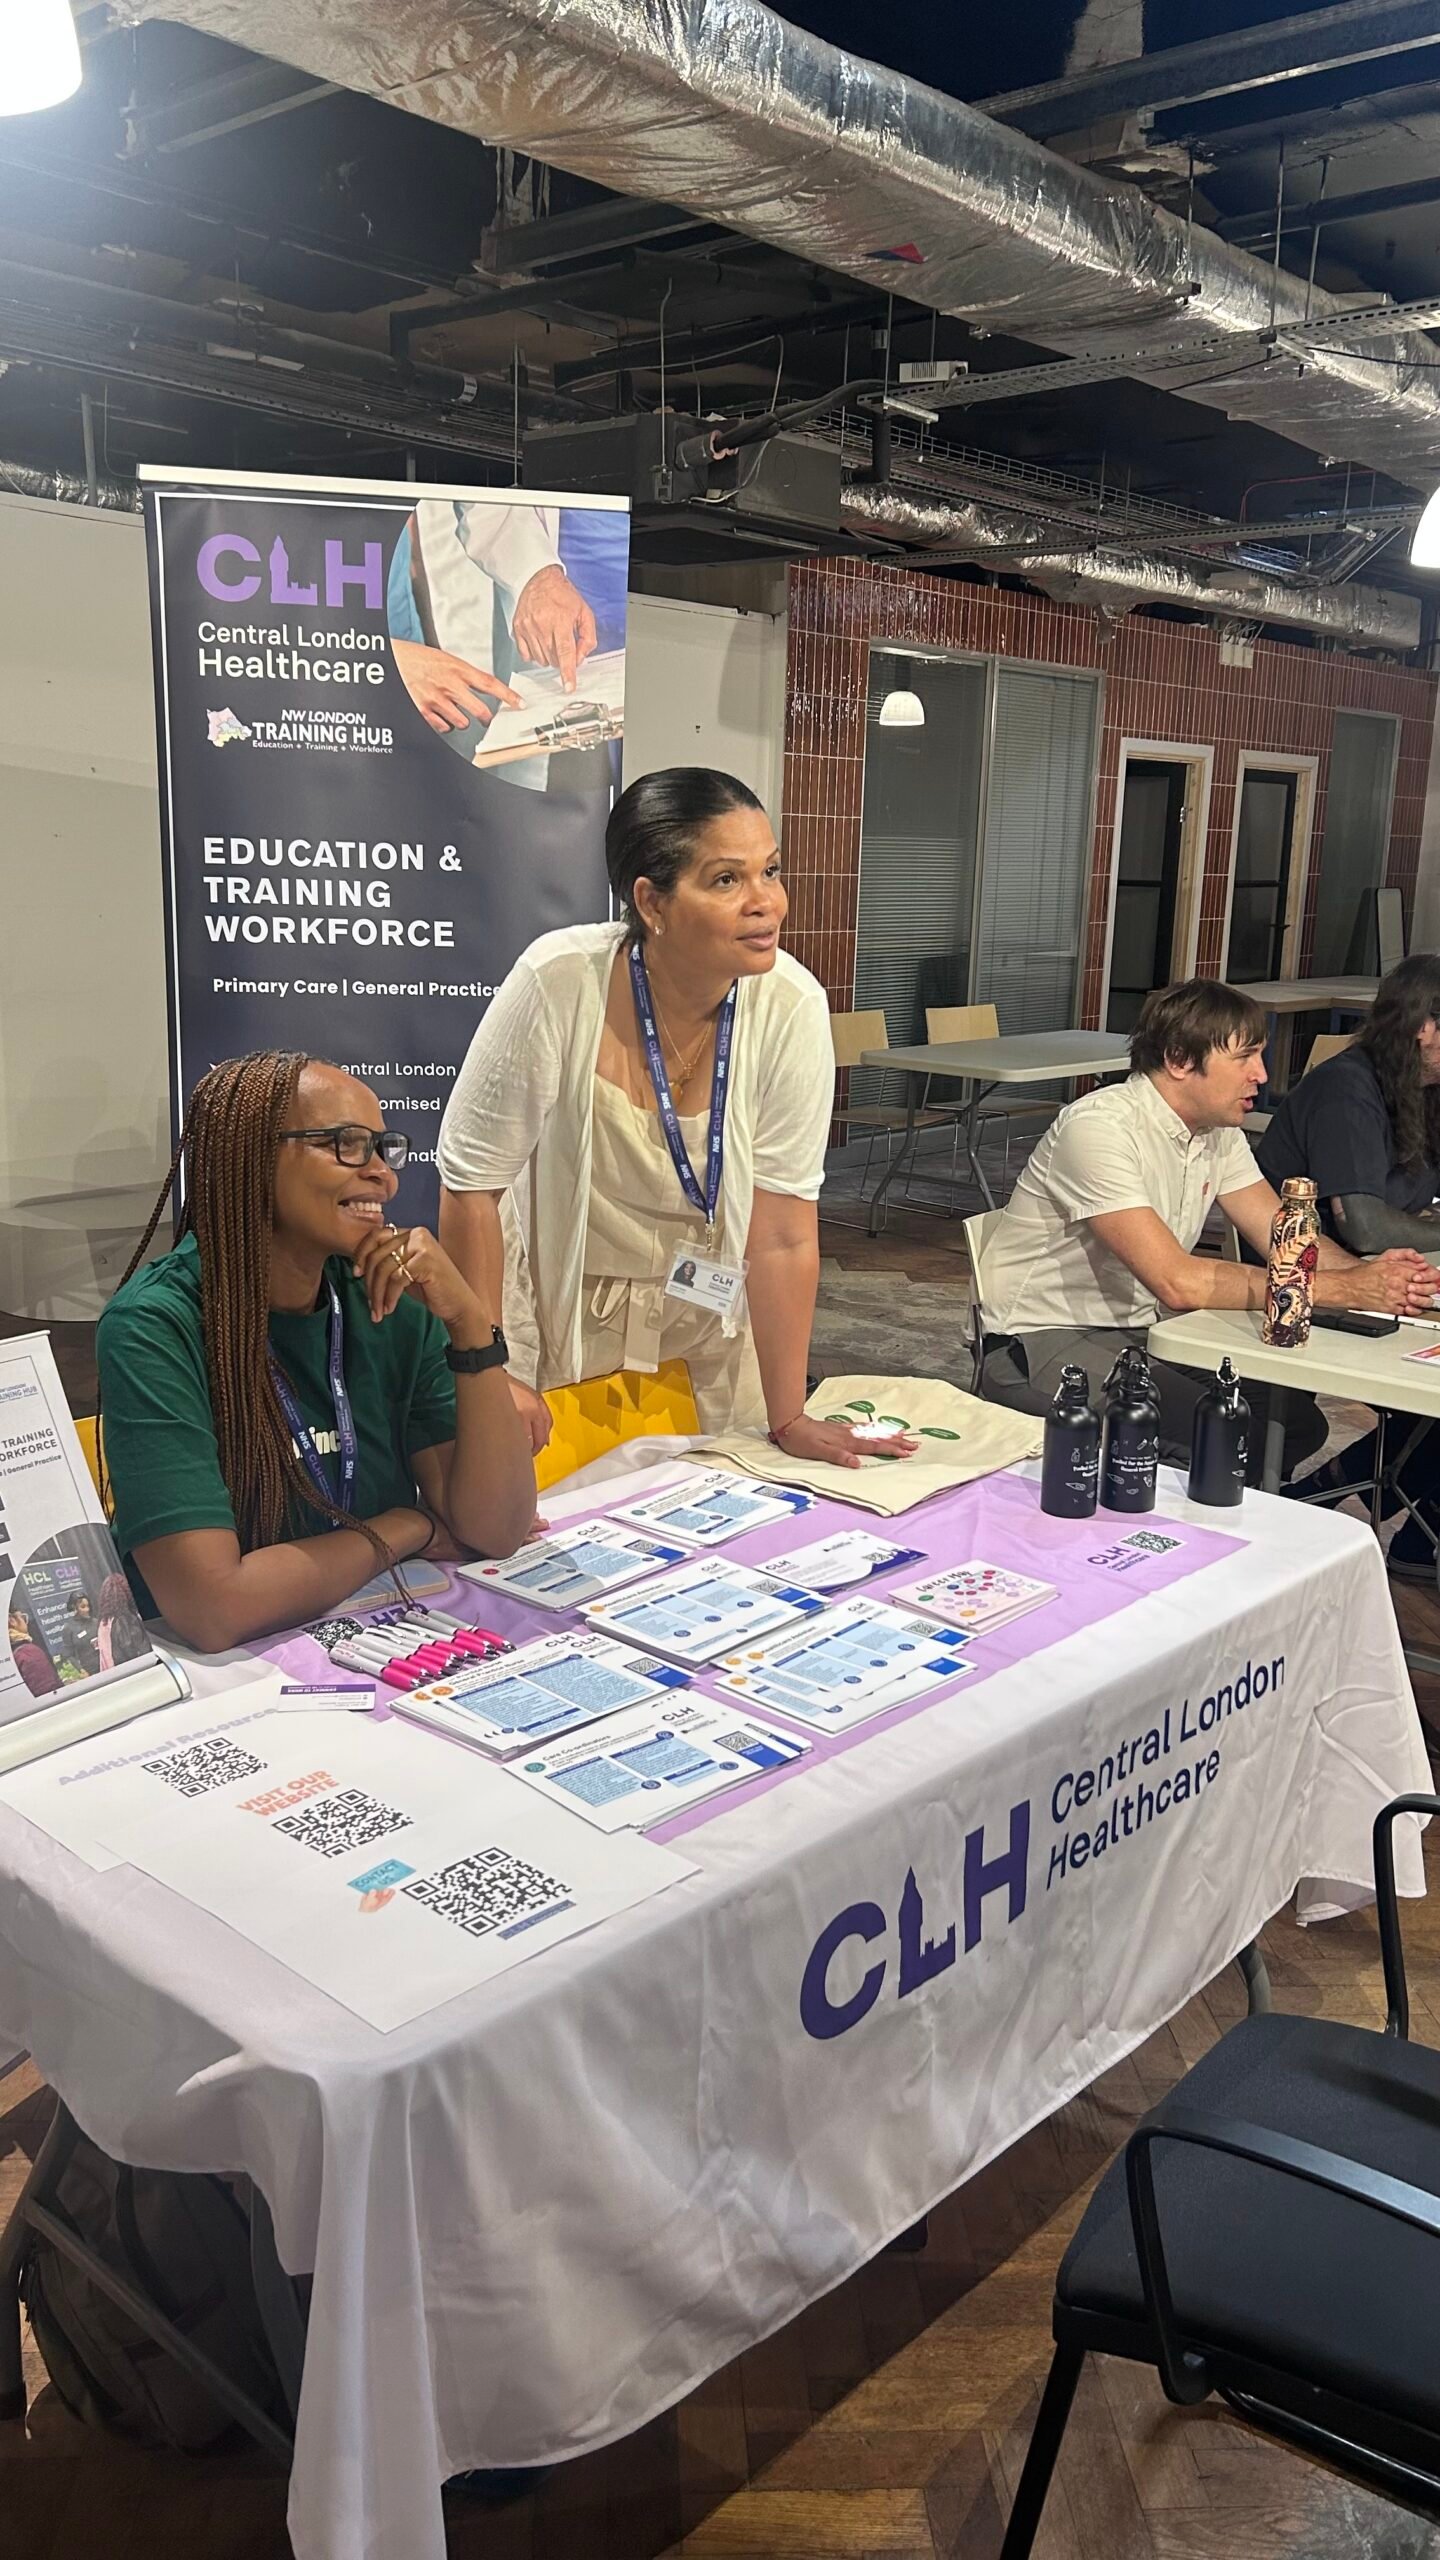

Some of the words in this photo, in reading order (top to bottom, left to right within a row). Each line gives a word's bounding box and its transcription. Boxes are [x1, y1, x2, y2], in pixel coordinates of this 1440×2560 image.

[197, 533, 383, 609] CLH
[198, 621, 290, 646] Central
[297, 625, 385, 651] London
[198, 648, 385, 685] Healthcare
[281, 709, 305, 722] NW
[308, 711, 366, 725] LONDON
[252, 722, 347, 744] TRAINING
[352, 727, 393, 746] HUB
[252, 739, 294, 750] Education
[304, 742, 338, 752] Training
[350, 745, 393, 754] Workforce
[203, 837, 424, 871] EDUCATION
[439, 845, 462, 872] &
[203, 876, 391, 908] TRAINING
[205, 915, 455, 947] WORKFORCE
[213, 978, 289, 997] Primary
[294, 980, 338, 995] Care
[352, 981, 424, 997] General
[340, 1062, 389, 1076] entral
[395, 1062, 456, 1076] London
[378, 1096, 441, 1110] omised
[660, 1091, 671, 1110] NHS
[712, 1273, 734, 1287] CLH
[1, 1428, 54, 1448] TRAINING
[298, 1431, 311, 1450] NHS
[0, 1439, 57, 1462] ORKFORCE
[1087, 1546, 1130, 1564] CLH
[22, 1571, 52, 1585] HCL
[55, 1565, 79, 1579] CLH
[545, 1635, 575, 1647] CLH
[571, 1636, 601, 1648] CLH
[662, 1707, 695, 1721] CLH
[58, 1741, 176, 1786] Additional
[176, 1707, 277, 1744] Resource
[1050, 1707, 1171, 1824] Central
[1179, 1655, 1285, 1743] London
[236, 1786, 287, 1813] VISIT
[286, 1769, 332, 1794] OUR
[253, 1777, 340, 1817] WEBSITE
[1046, 1749, 1221, 1891] Healthcare
[800, 1799, 1030, 2040] CLH
